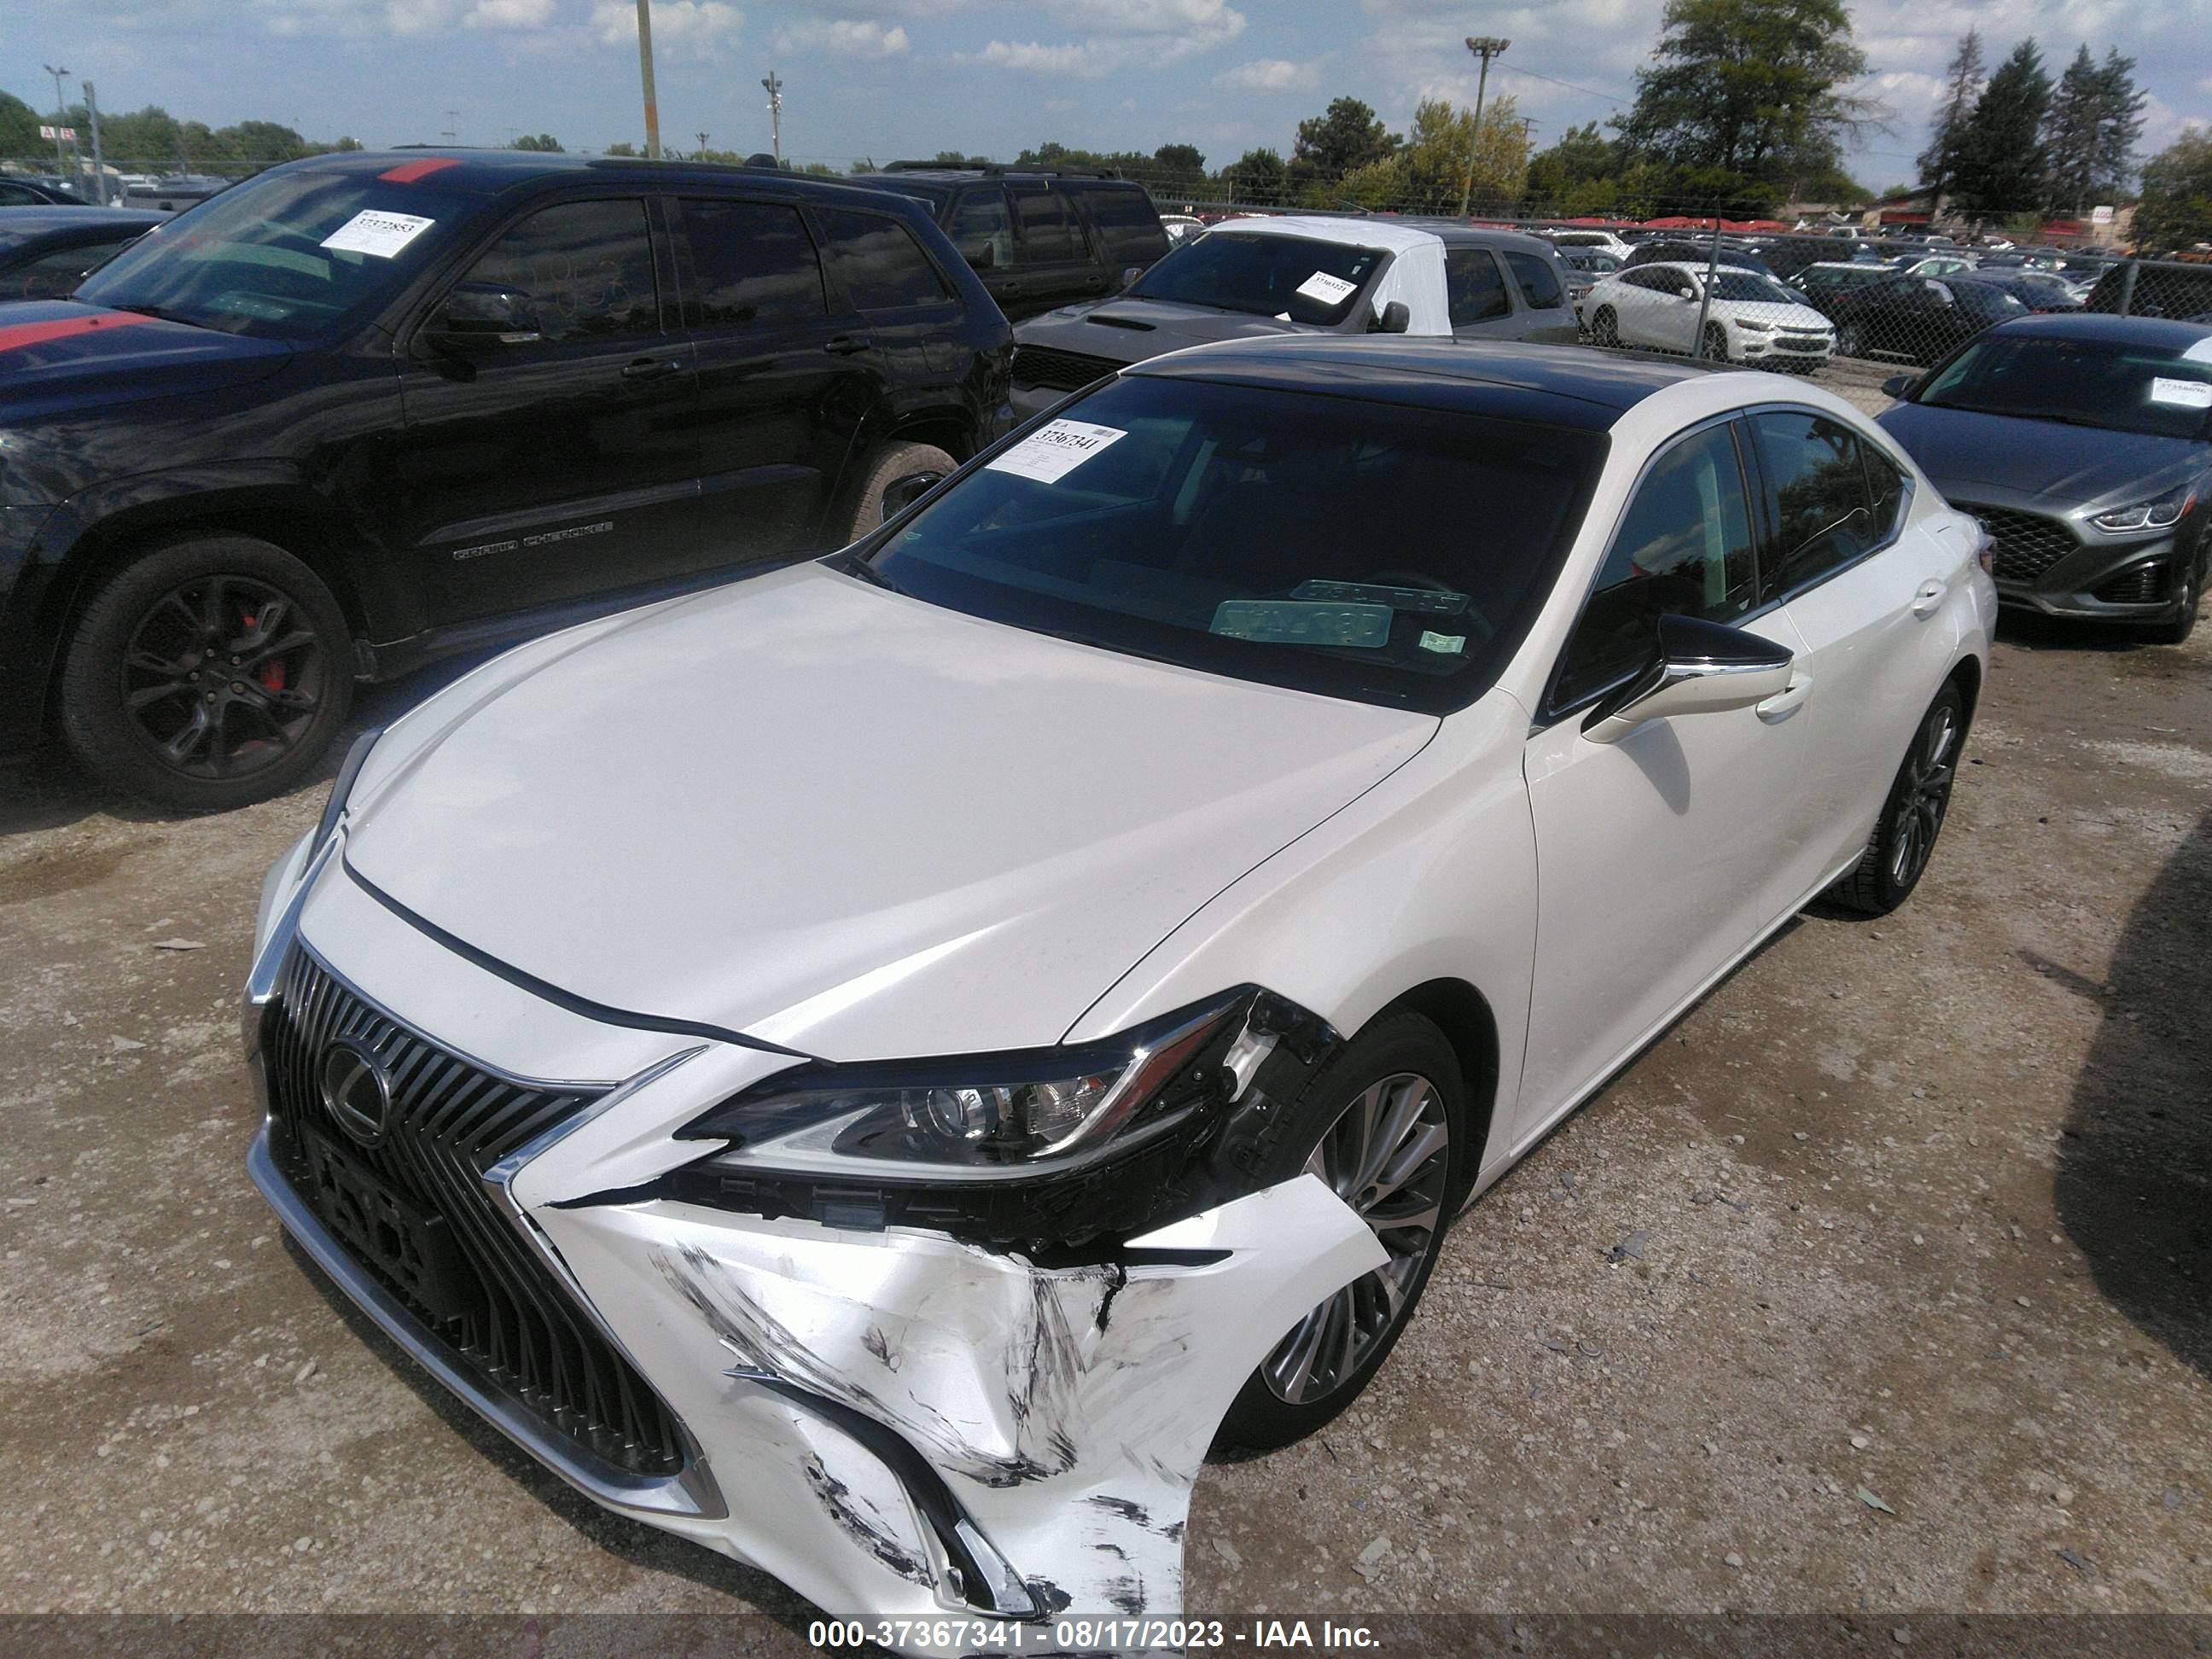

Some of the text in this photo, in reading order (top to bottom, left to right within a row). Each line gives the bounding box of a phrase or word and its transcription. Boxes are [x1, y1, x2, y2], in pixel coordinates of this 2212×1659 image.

[44, 126, 53, 138] A
[354, 218, 416, 233] 37372853
[1035, 430, 1099, 450] 37367341
[453, 521, 614, 560] GRAND CHEROKEE
